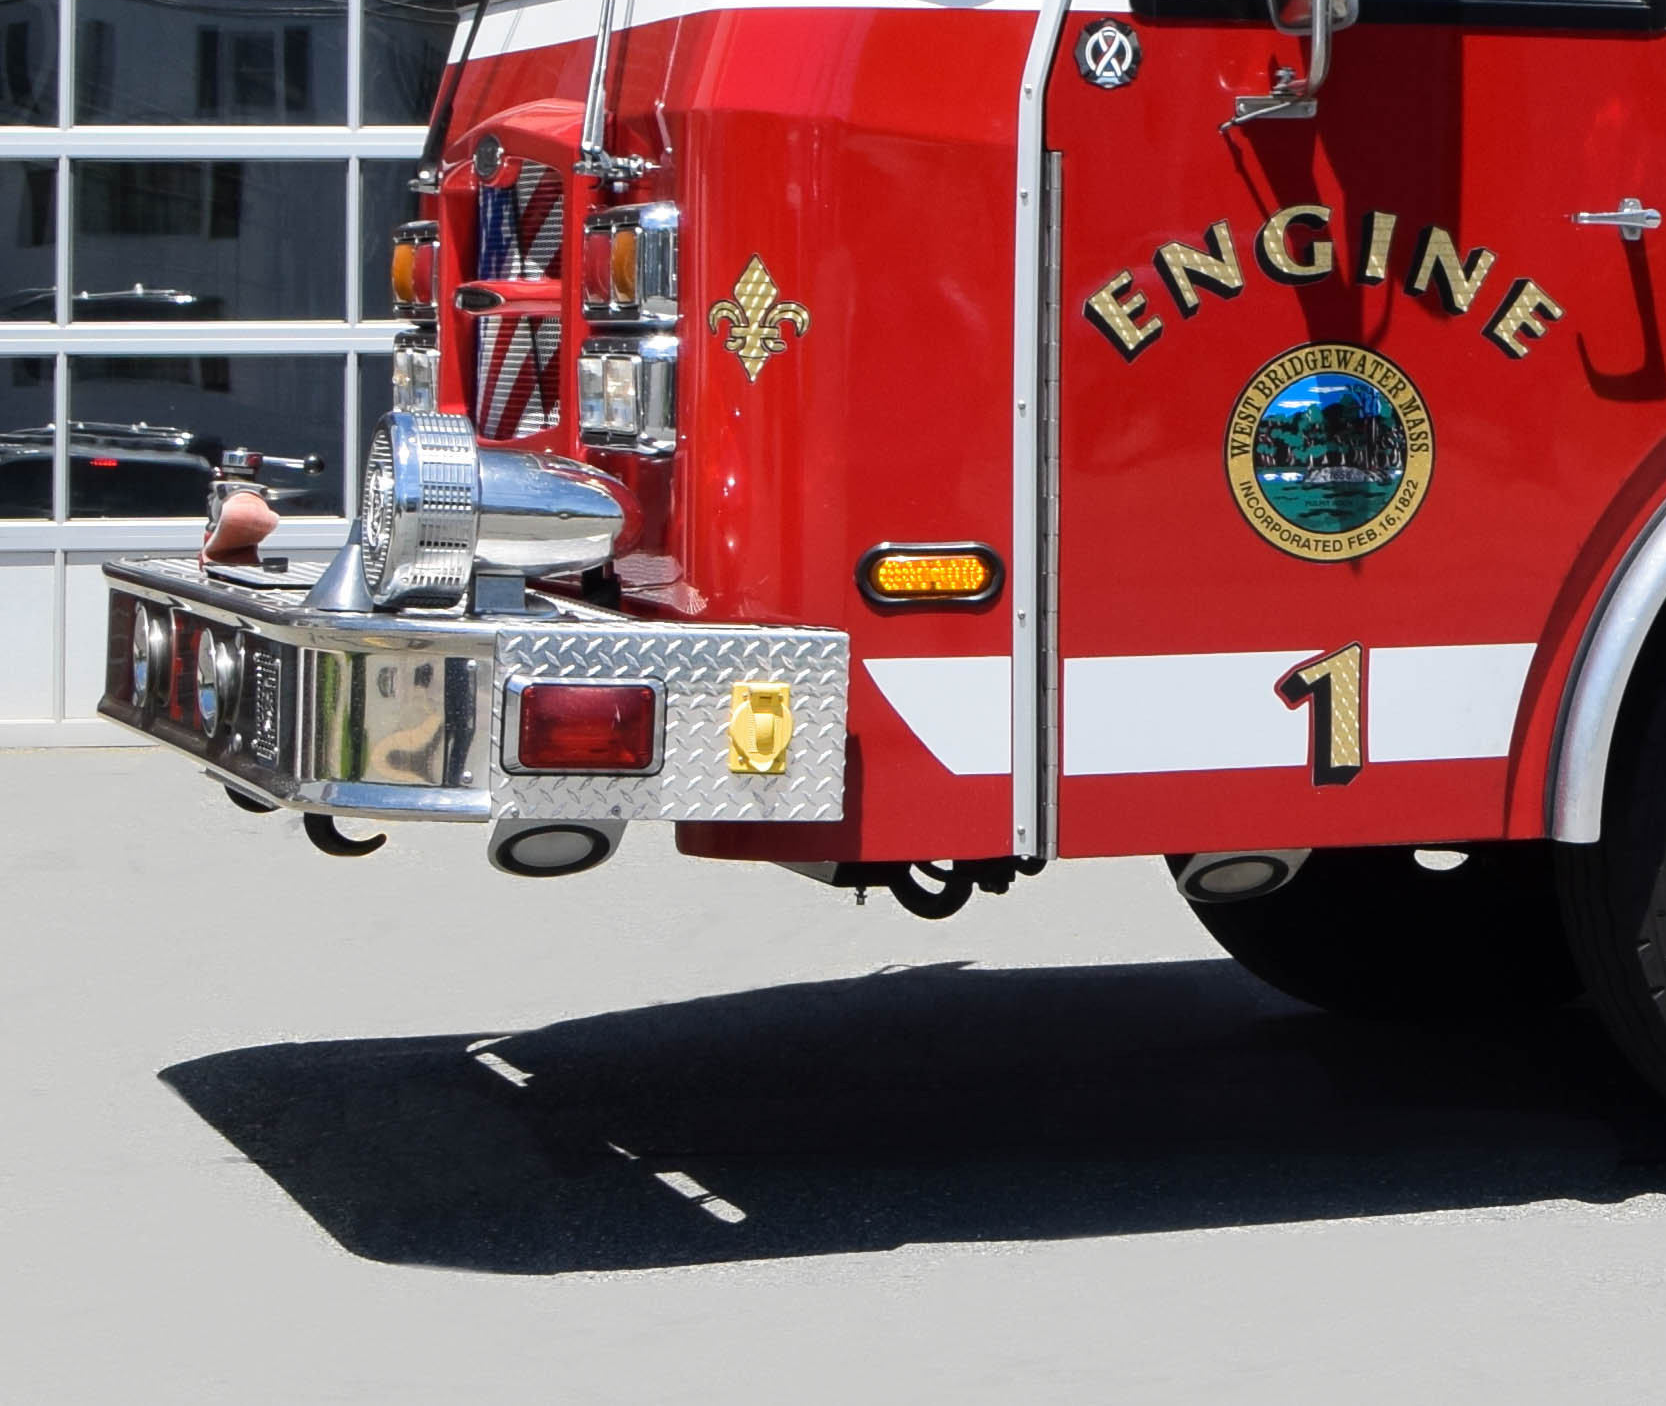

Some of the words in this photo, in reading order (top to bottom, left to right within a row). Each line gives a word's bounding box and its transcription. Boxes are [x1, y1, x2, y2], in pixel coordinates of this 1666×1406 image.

[1082, 203, 1564, 364] ENGINE
[1231, 397, 1262, 459] WEST
[1253, 349, 1407, 400] BRIDGEWATER
[1398, 392, 1430, 459] MASS.
[1239, 481, 1344, 553] INCORPORATED
[1275, 641, 1363, 785] 1
